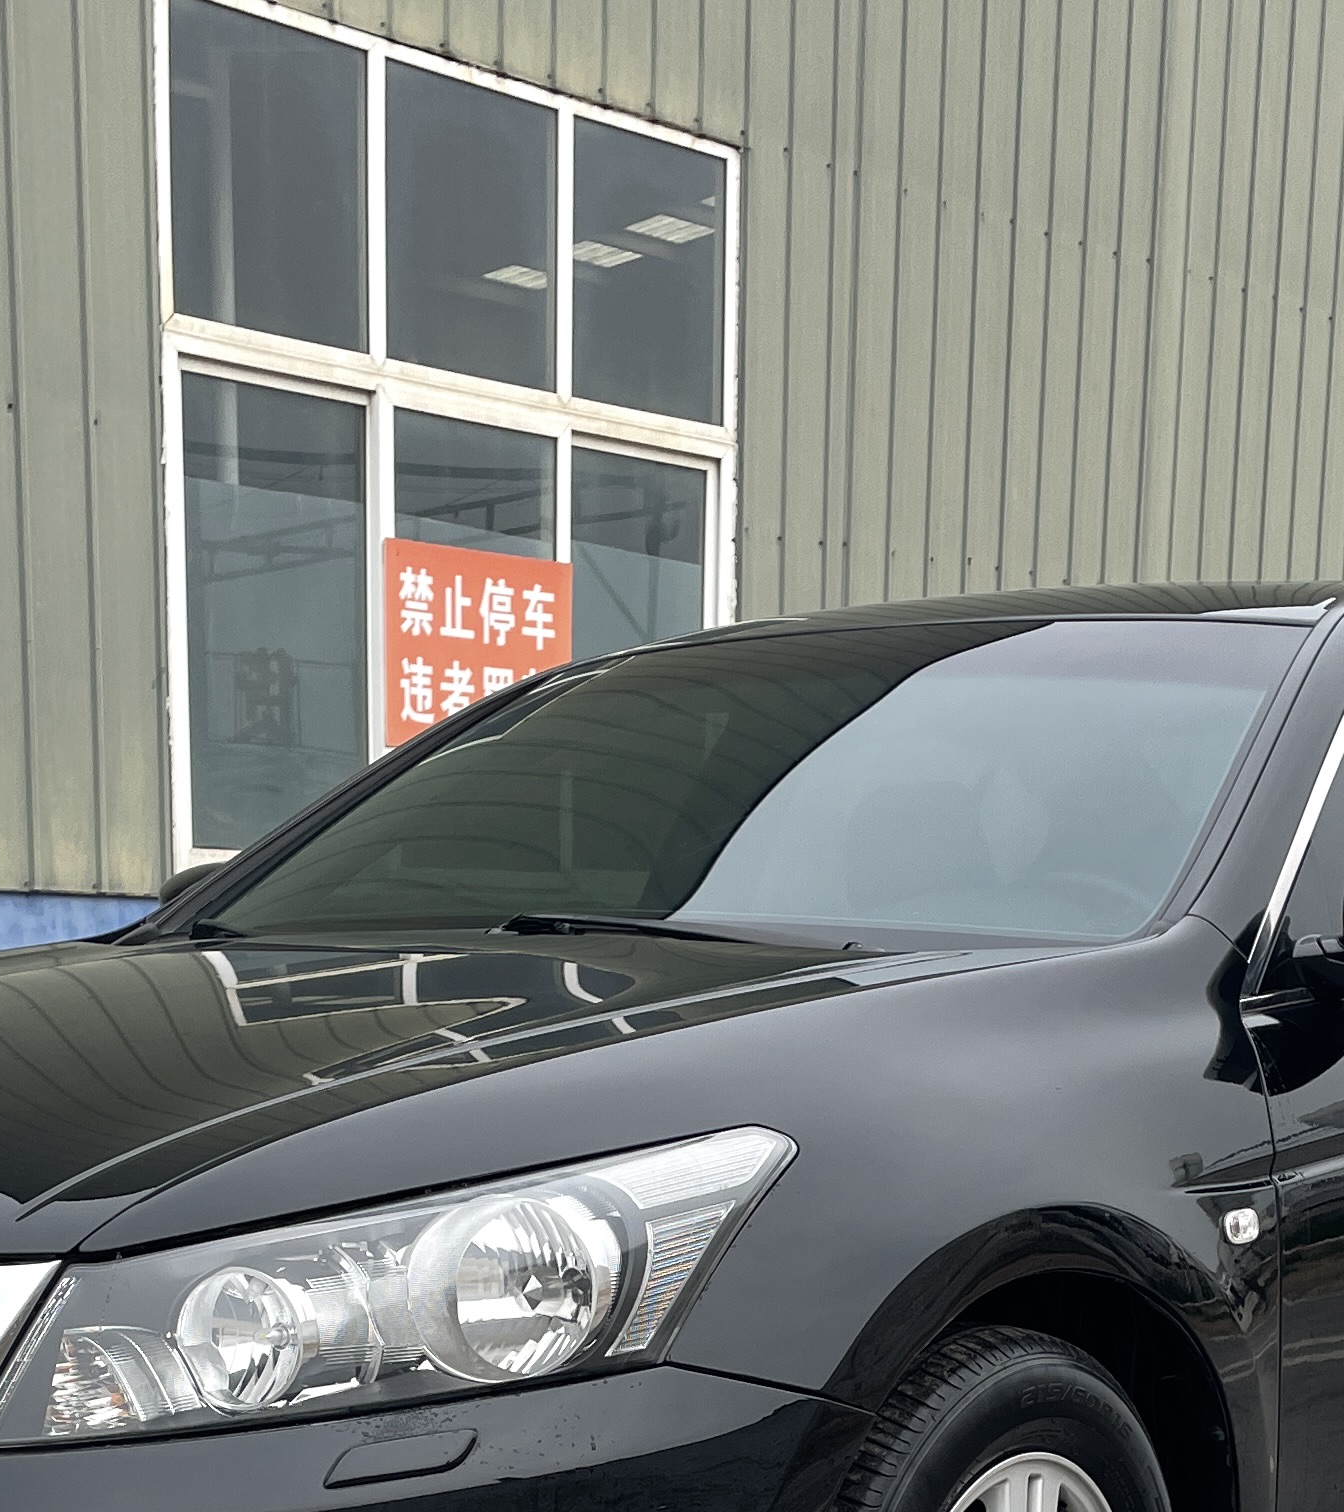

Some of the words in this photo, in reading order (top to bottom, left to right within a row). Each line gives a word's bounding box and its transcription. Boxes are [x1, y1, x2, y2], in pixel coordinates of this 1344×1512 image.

[399, 566, 555, 650] 禁止停车
[400, 656, 541, 724] 违者
